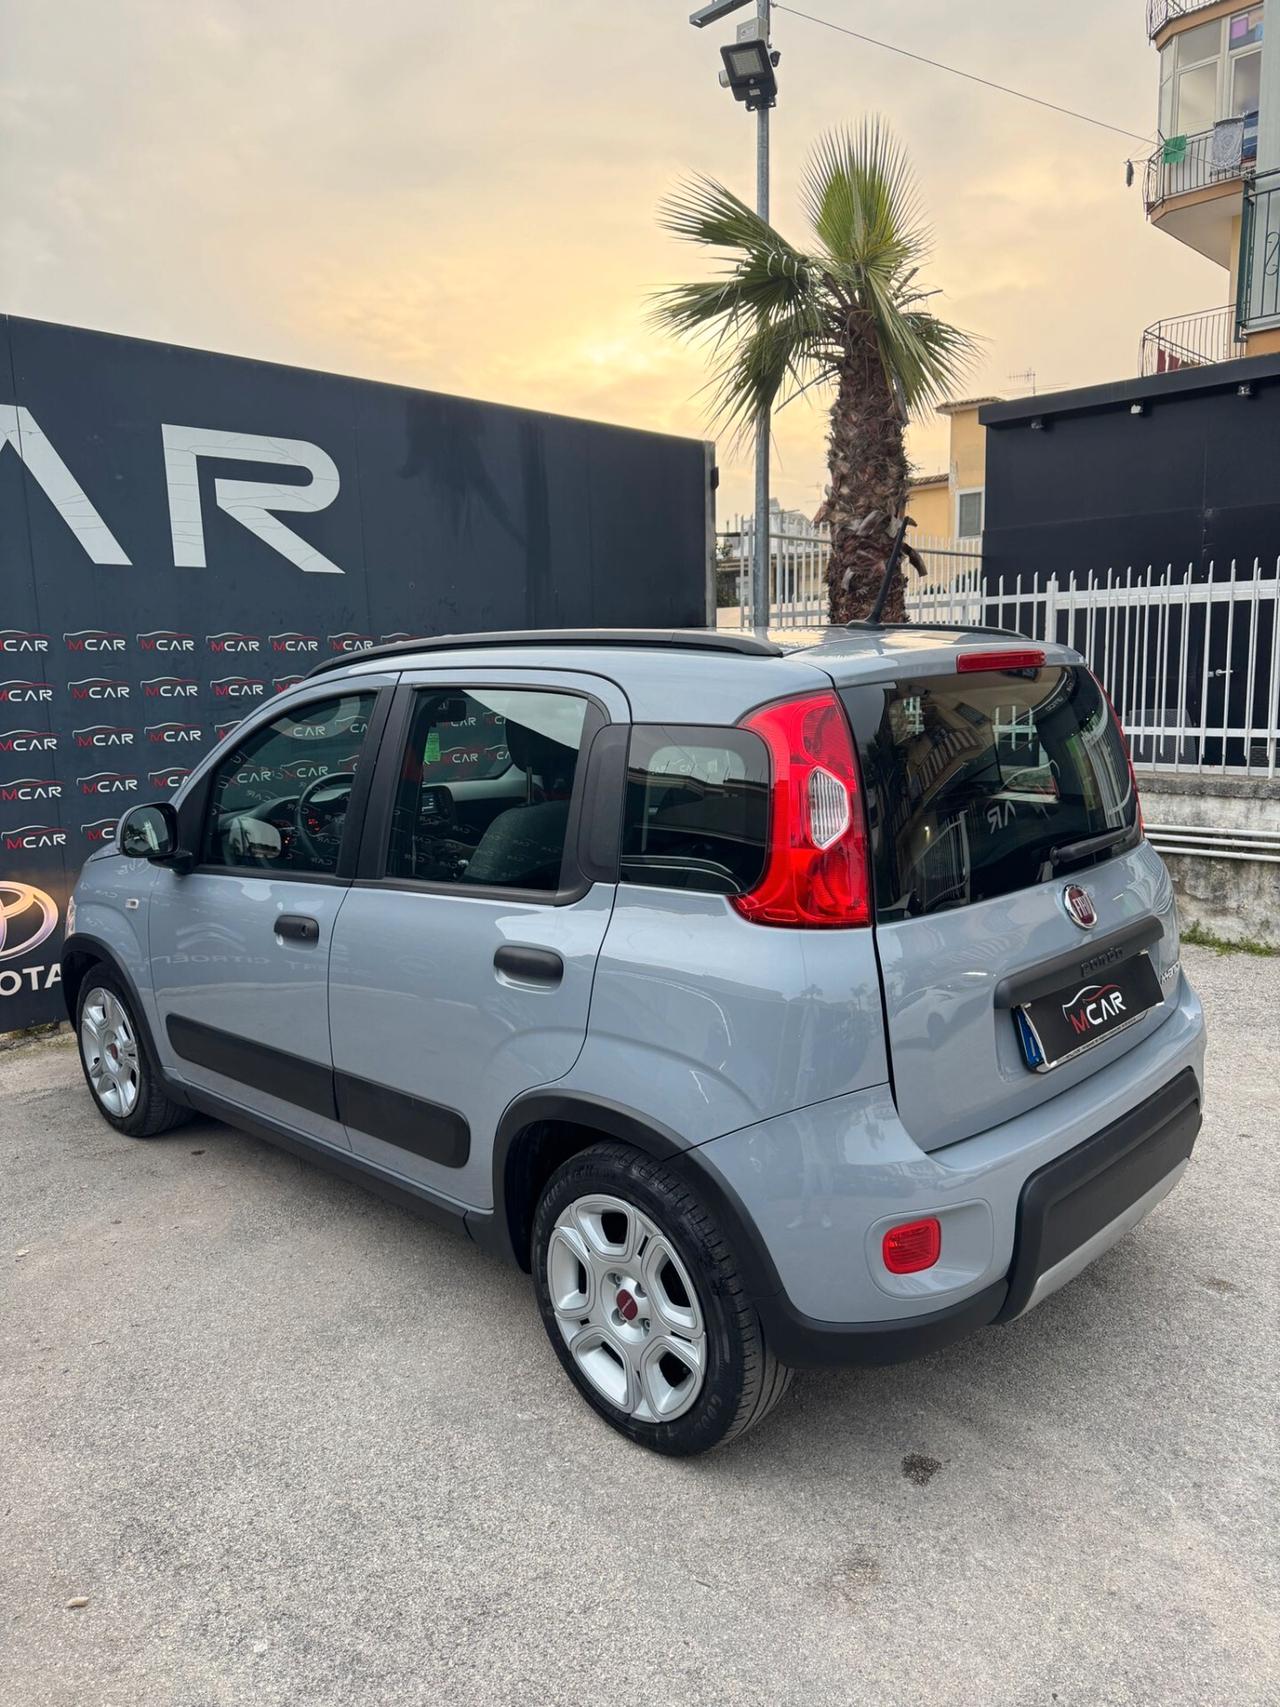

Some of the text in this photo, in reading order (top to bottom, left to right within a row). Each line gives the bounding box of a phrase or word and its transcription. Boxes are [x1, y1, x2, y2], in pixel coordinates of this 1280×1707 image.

[0, 640, 48, 652] CAR
[66, 639, 126, 651] MCAR
[140, 639, 194, 651] MCAR
[210, 640, 260, 653] MCAR
[272, 640, 318, 653] MCAR
[332, 640, 373, 651] MCAR
[72, 686, 130, 699] MCAR
[145, 685, 198, 697] MCAR
[215, 684, 263, 696] MCAR
[77, 733, 133, 747] MCAR
[150, 730, 201, 743] MCAR
[0, 738, 57, 751] MCAR
[2, 786, 62, 800] MCAR
[82, 779, 138, 794] MCAR
[87, 827, 115, 841] MC
[6, 833, 67, 849] MCAR
[1070, 991, 1127, 1034] MCAR
